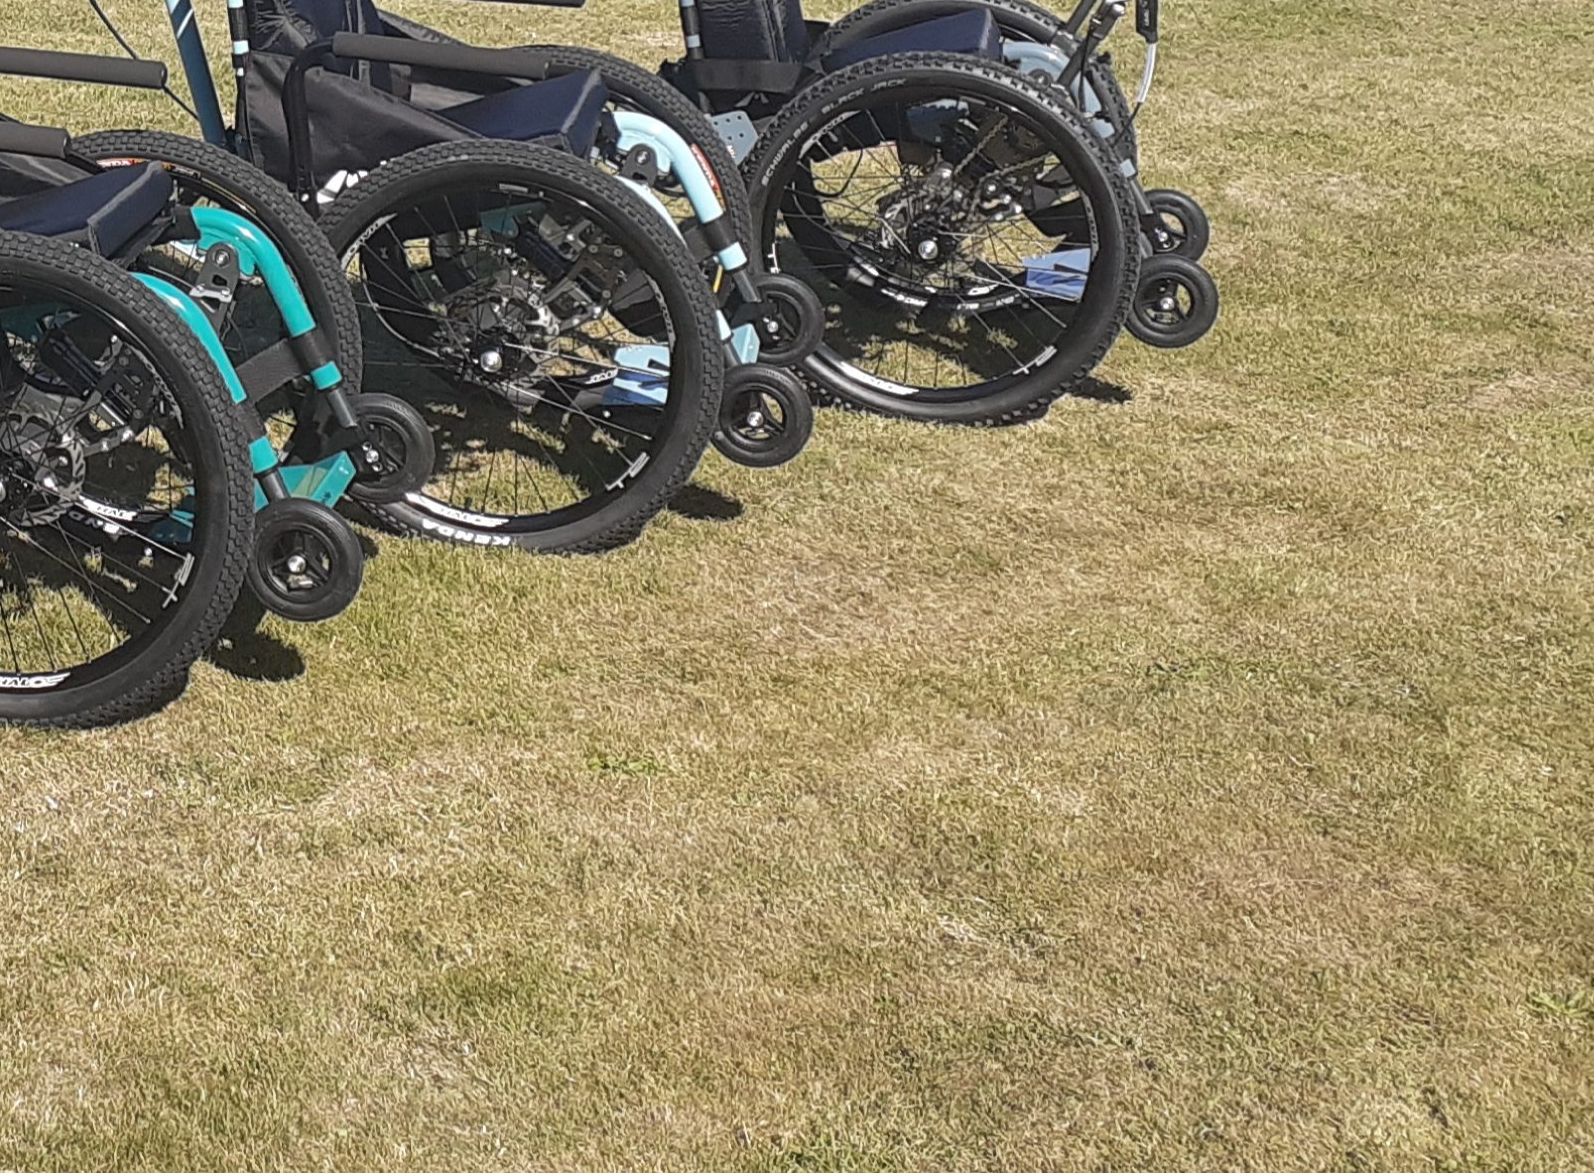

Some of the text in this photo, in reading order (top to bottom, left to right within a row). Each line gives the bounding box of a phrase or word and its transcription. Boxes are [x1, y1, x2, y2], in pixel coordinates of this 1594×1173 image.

[821, 78, 907, 114] BLACK JACK
[761, 121, 808, 186] SCHWALBE
[422, 518, 510, 546] KENDA
